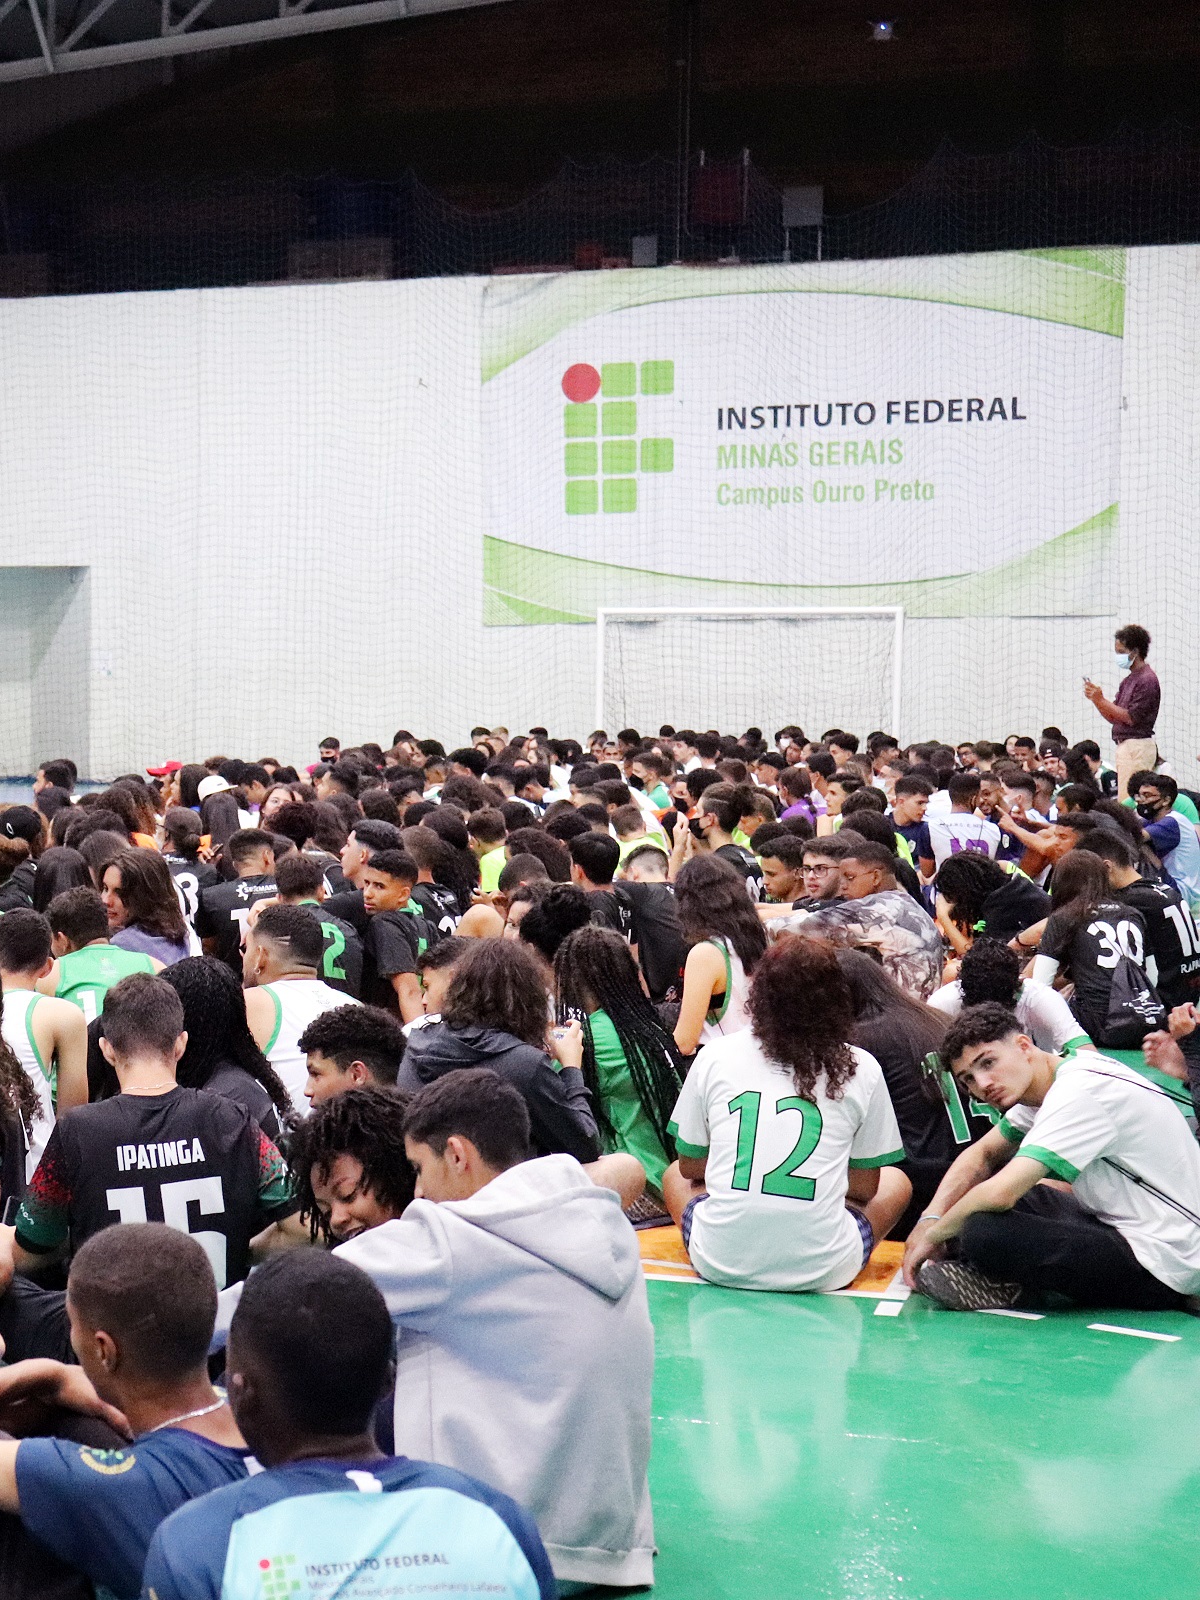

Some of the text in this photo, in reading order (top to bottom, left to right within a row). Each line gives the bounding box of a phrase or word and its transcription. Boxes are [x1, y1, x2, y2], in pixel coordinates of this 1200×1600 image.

[716, 396, 1027, 431] INSTITUTO FEDERAL
[716, 437, 905, 470] MINAS GERAIS
[716, 478, 936, 510] Campus Ouro Preto
[1086, 919, 1144, 969] 30
[116, 1137, 206, 1172] IPATINGA
[728, 1090, 823, 1201] 12
[305, 1553, 451, 1577] INSTITUTO FEDERAL
